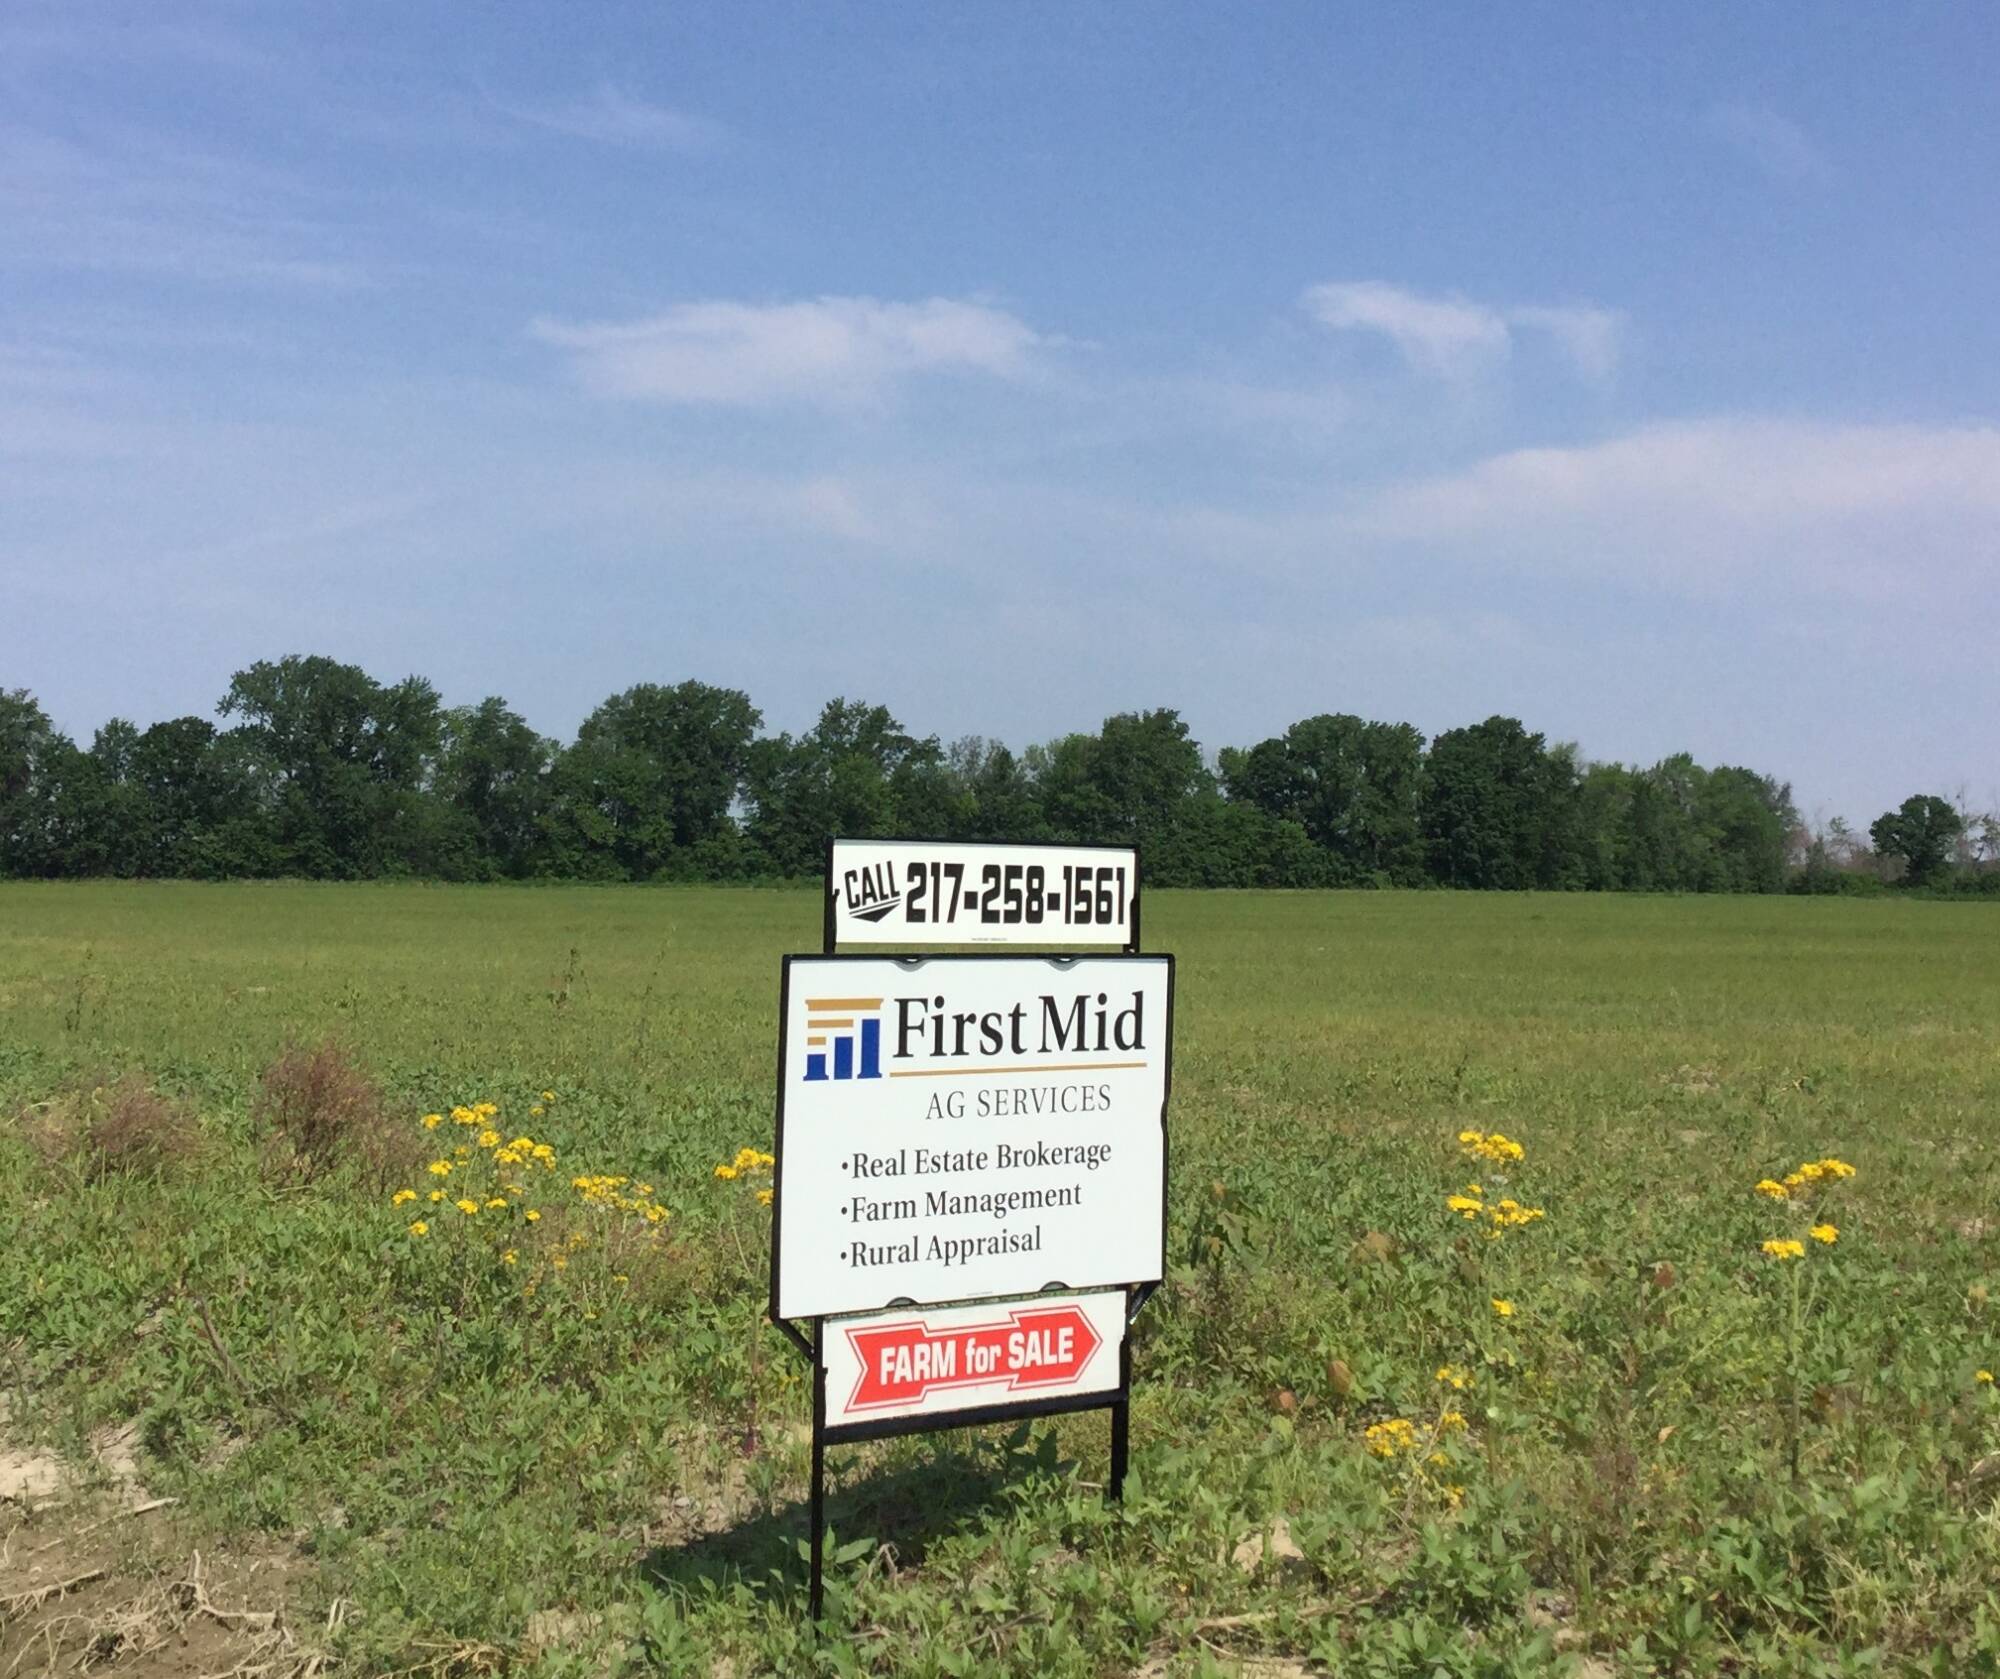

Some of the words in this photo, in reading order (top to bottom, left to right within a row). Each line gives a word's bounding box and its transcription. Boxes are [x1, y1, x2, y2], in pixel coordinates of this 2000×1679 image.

[844, 860, 900, 909] CALL
[906, 862, 1125, 924] 217-258-1561
[925, 1090, 965, 1120] AG
[976, 1084, 1112, 1117] SERVICES
[914, 1148, 988, 1175] Estate
[996, 1141, 1112, 1171] Brokerage
[925, 1183, 1082, 1219] Management
[926, 1225, 1042, 1267] Appraisal
[880, 1339, 956, 1386] FARM
[965, 1338, 1001, 1375] for
[1007, 1327, 1074, 1369] SALE
